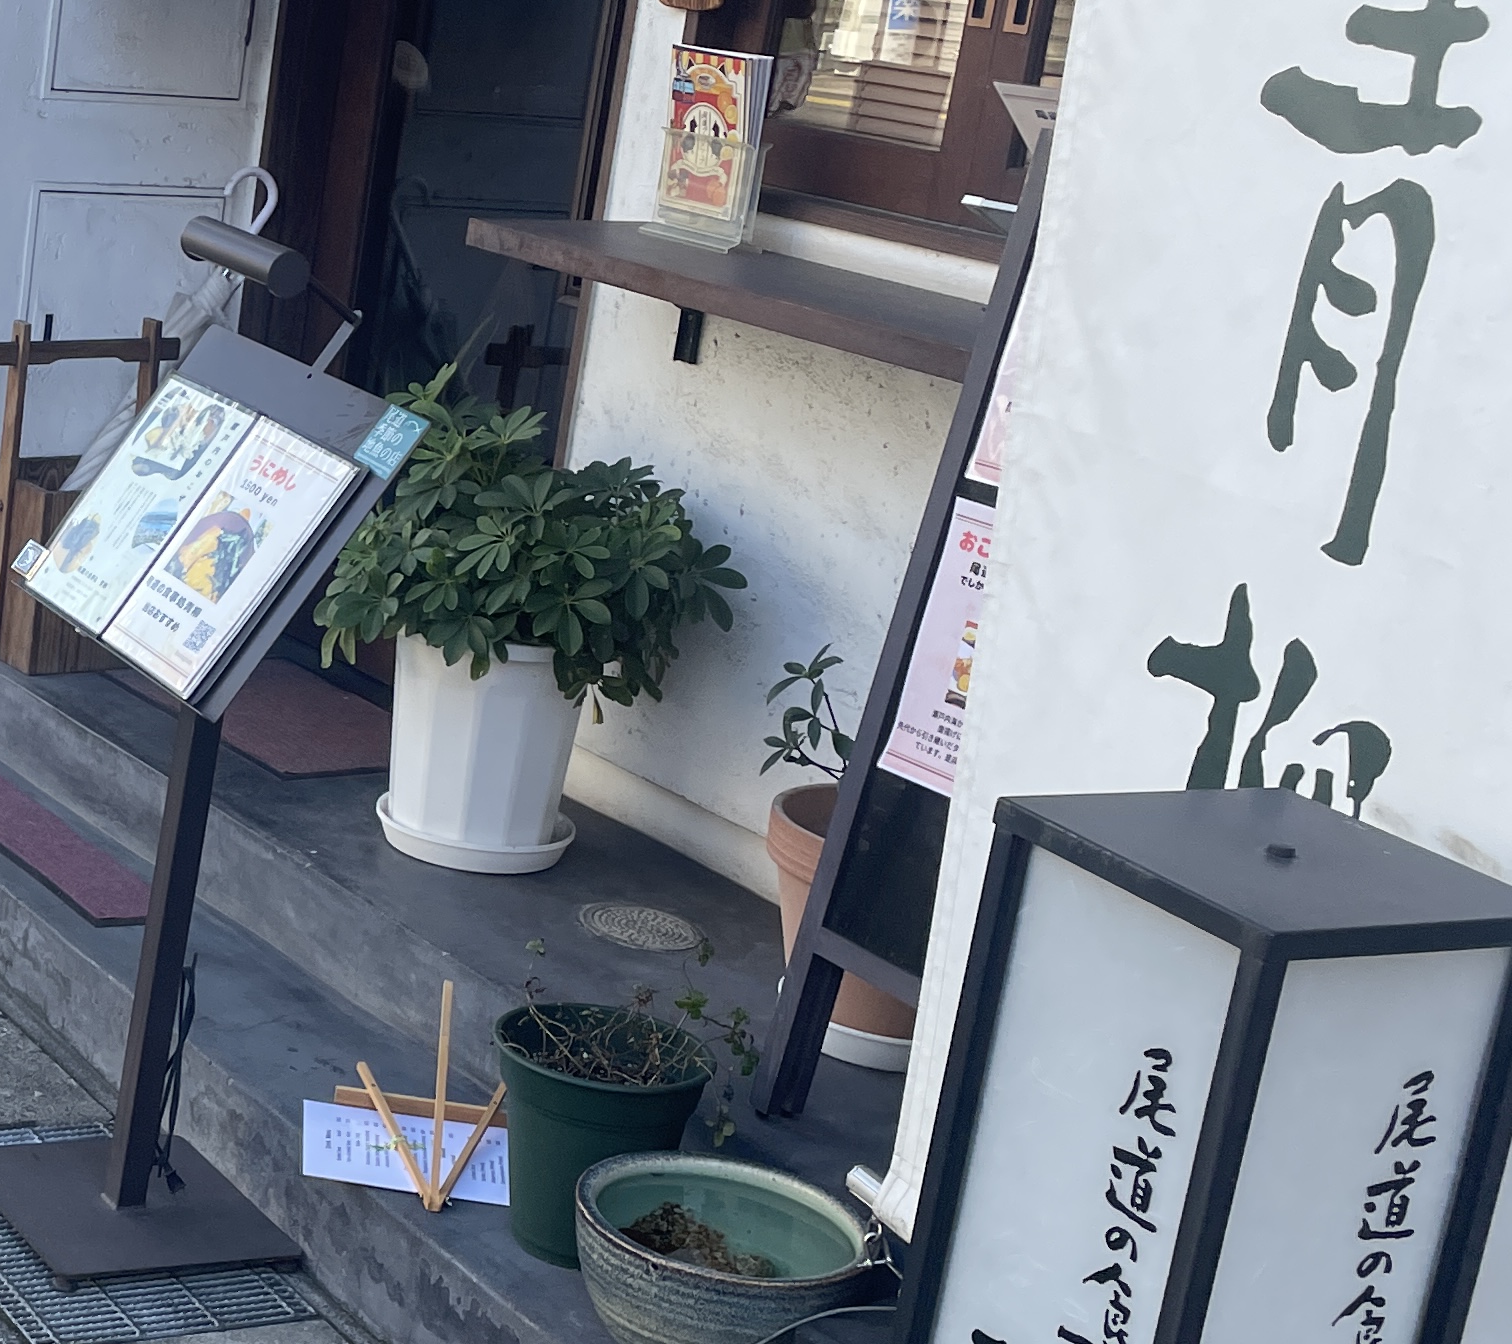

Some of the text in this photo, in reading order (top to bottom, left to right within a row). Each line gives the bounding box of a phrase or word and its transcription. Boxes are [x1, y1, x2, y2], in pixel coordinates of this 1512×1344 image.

[385, 406, 408, 429] 尾道
[373, 423, 404, 446] 季節の
[248, 455, 297, 492] うにめし
